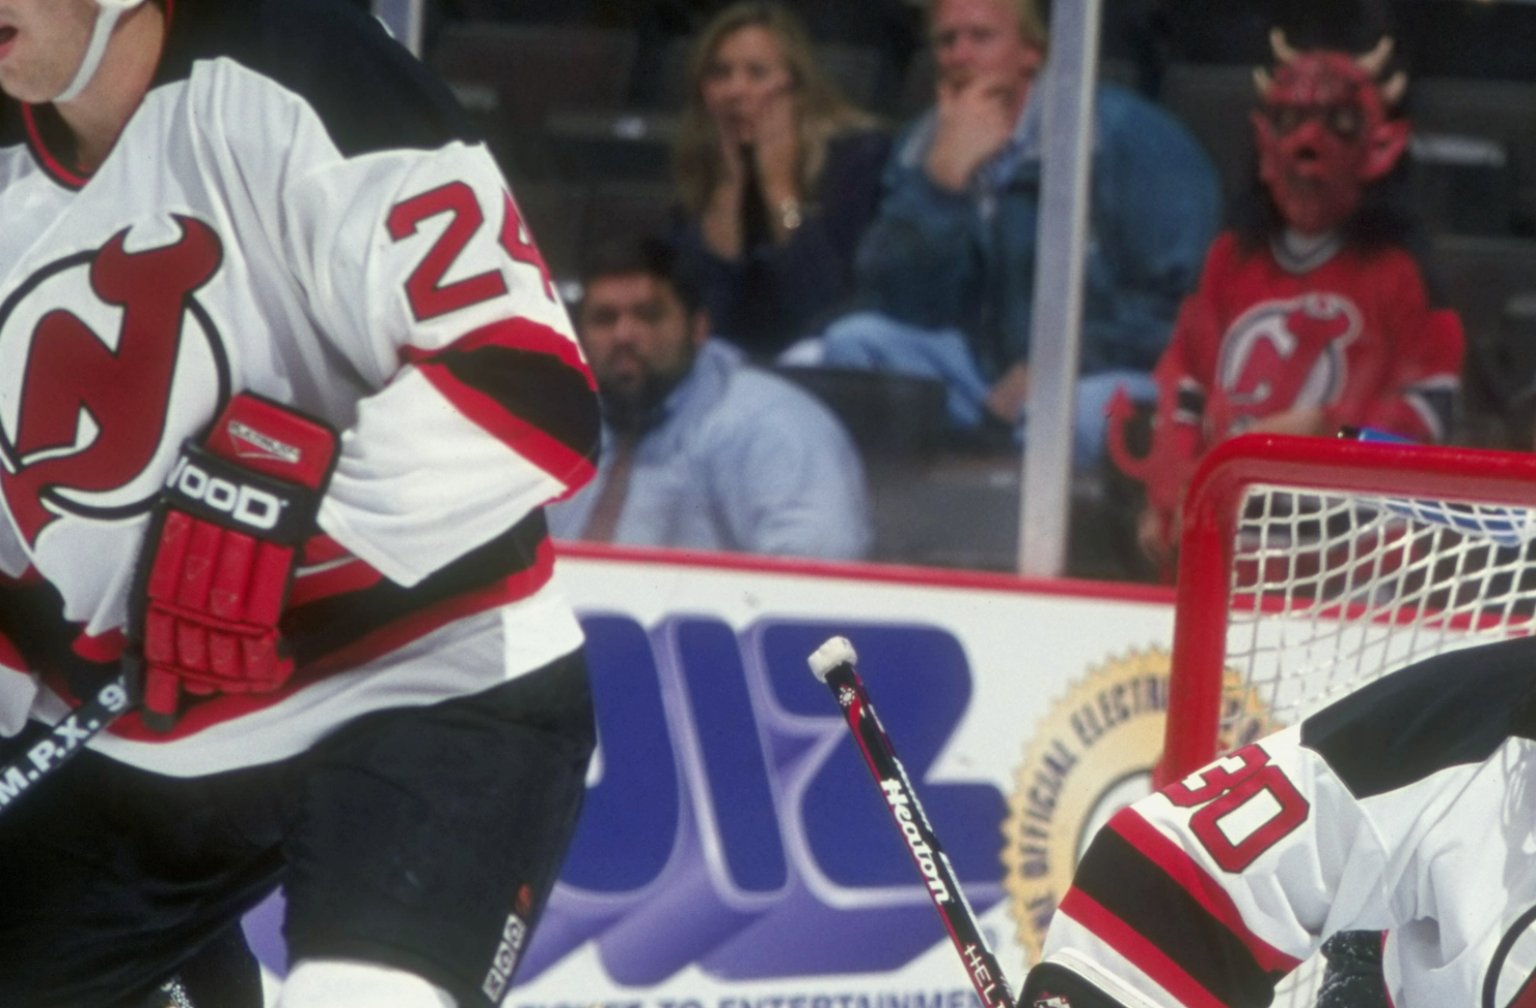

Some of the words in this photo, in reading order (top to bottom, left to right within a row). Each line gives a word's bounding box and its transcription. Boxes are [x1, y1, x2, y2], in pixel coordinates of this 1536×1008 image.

[166, 455, 281, 530] OOD
[880, 776, 950, 905] Heaton
[1160, 742, 1310, 874] 30
